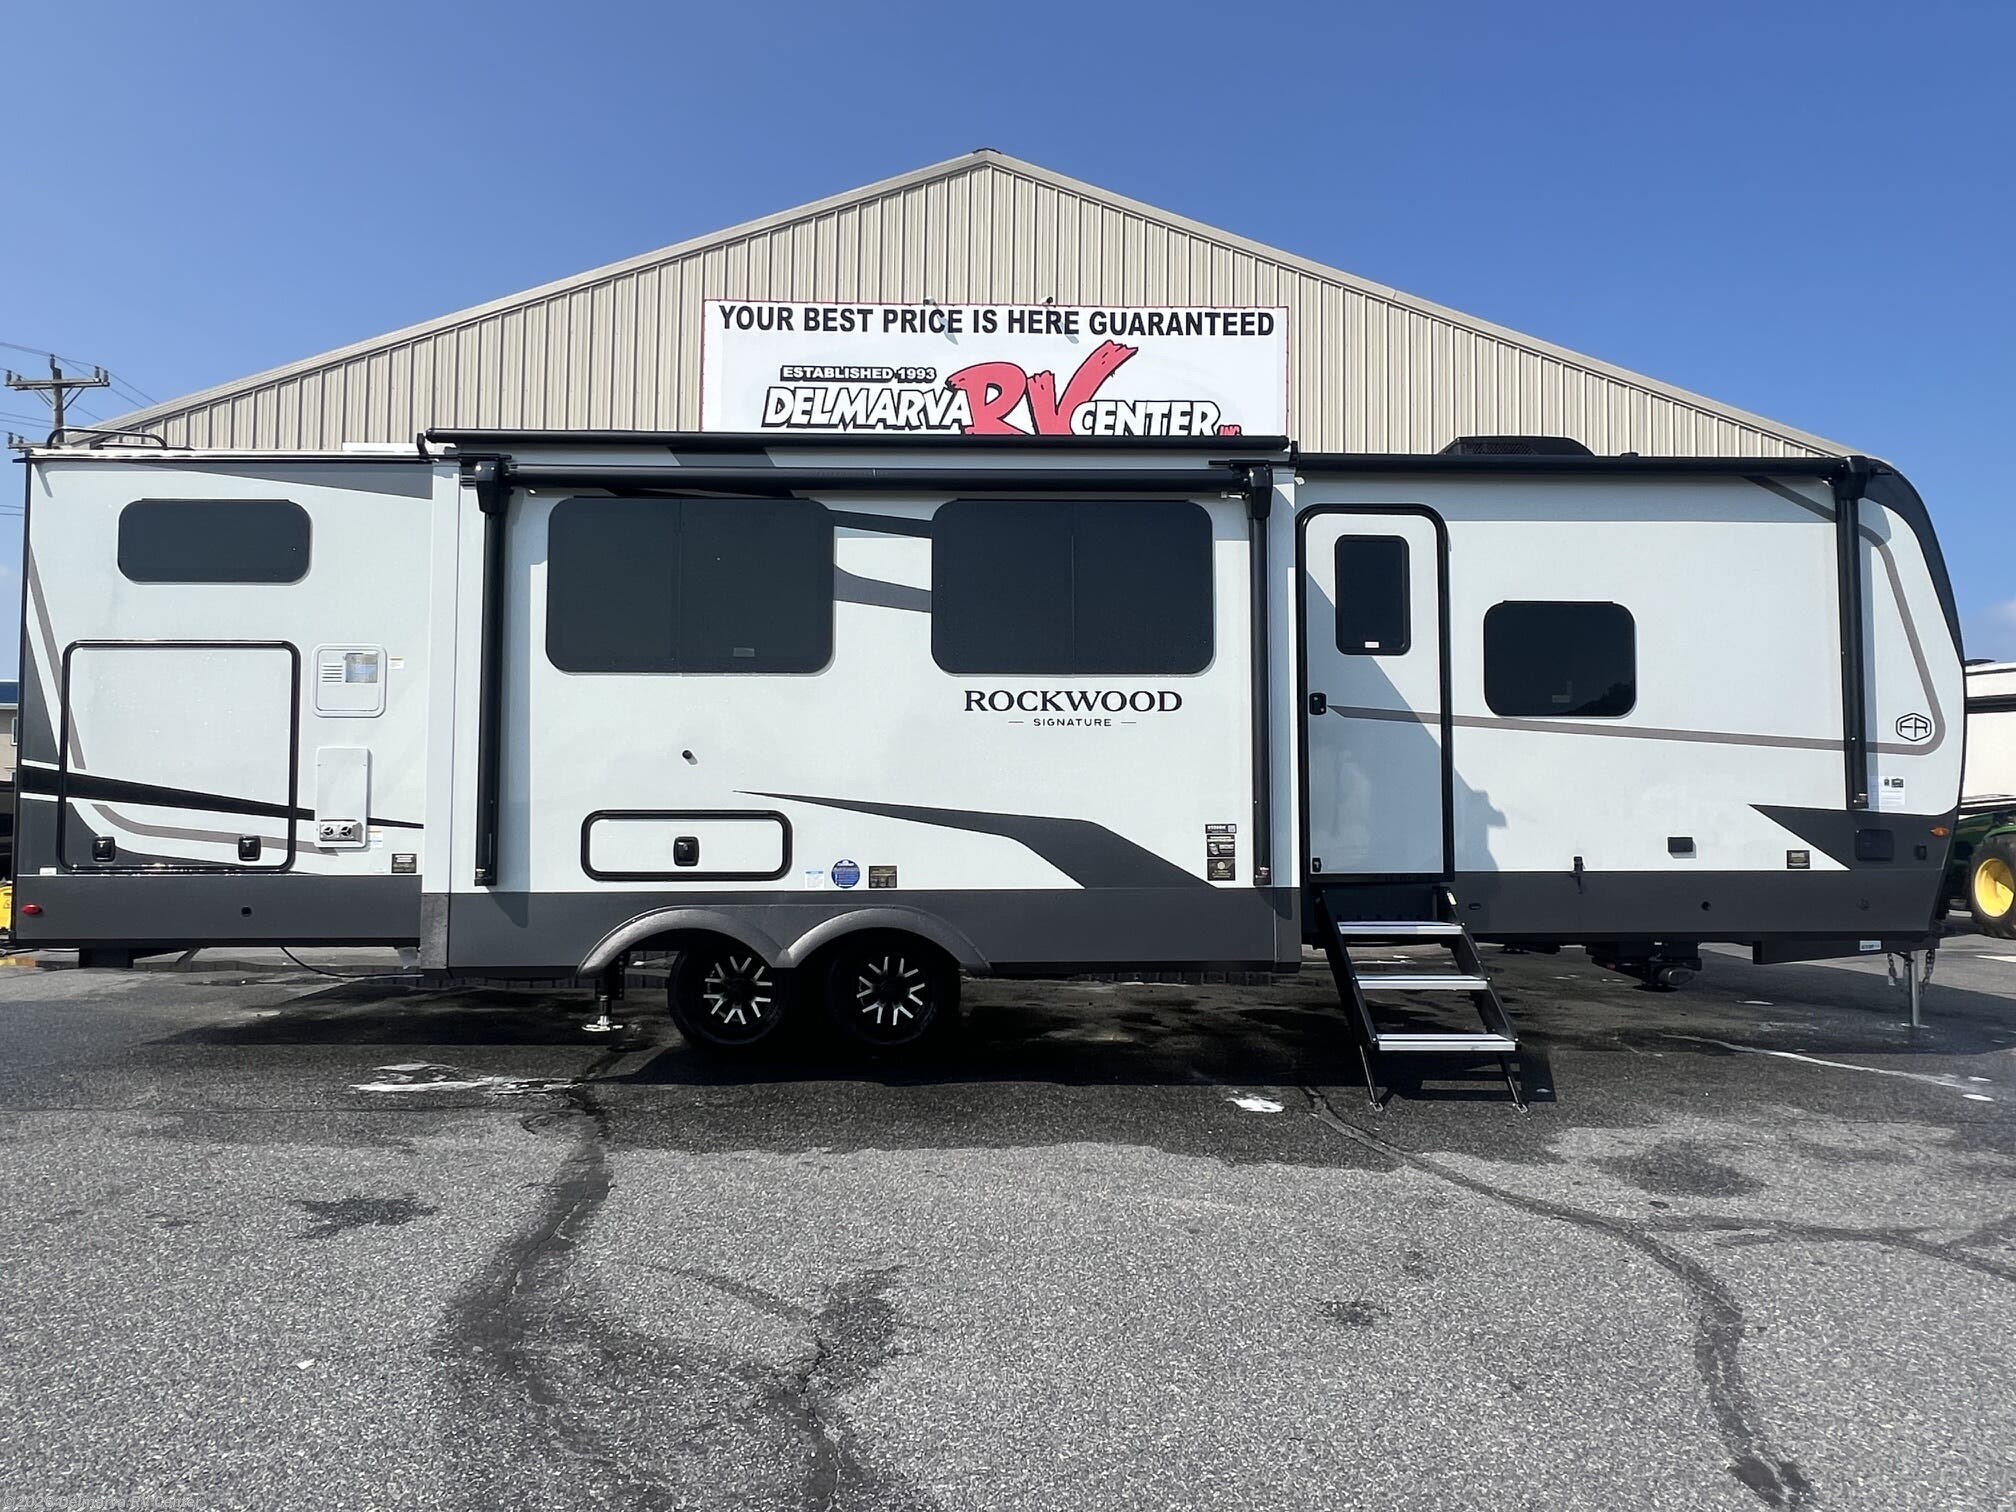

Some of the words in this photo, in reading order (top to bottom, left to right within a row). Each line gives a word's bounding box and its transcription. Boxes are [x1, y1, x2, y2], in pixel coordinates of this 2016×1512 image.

[719, 305, 794, 330] YOUR
[803, 307, 873, 332] BEST
[883, 308, 963, 334] PRICE
[974, 309, 998, 335] IS
[1008, 310, 1079, 335] HERE
[1089, 311, 1274, 337] GUARANTEED
[782, 366, 894, 381] ESTABLISHED
[896, 367, 936, 381] 1993
[762, 386, 973, 431] DELMARVA
[946, 340, 1139, 435] RV
[1071, 400, 1220, 435] CENTER
[964, 690, 1183, 712] ROCKWOOD
[1033, 718, 1113, 727] SIGNATURE
